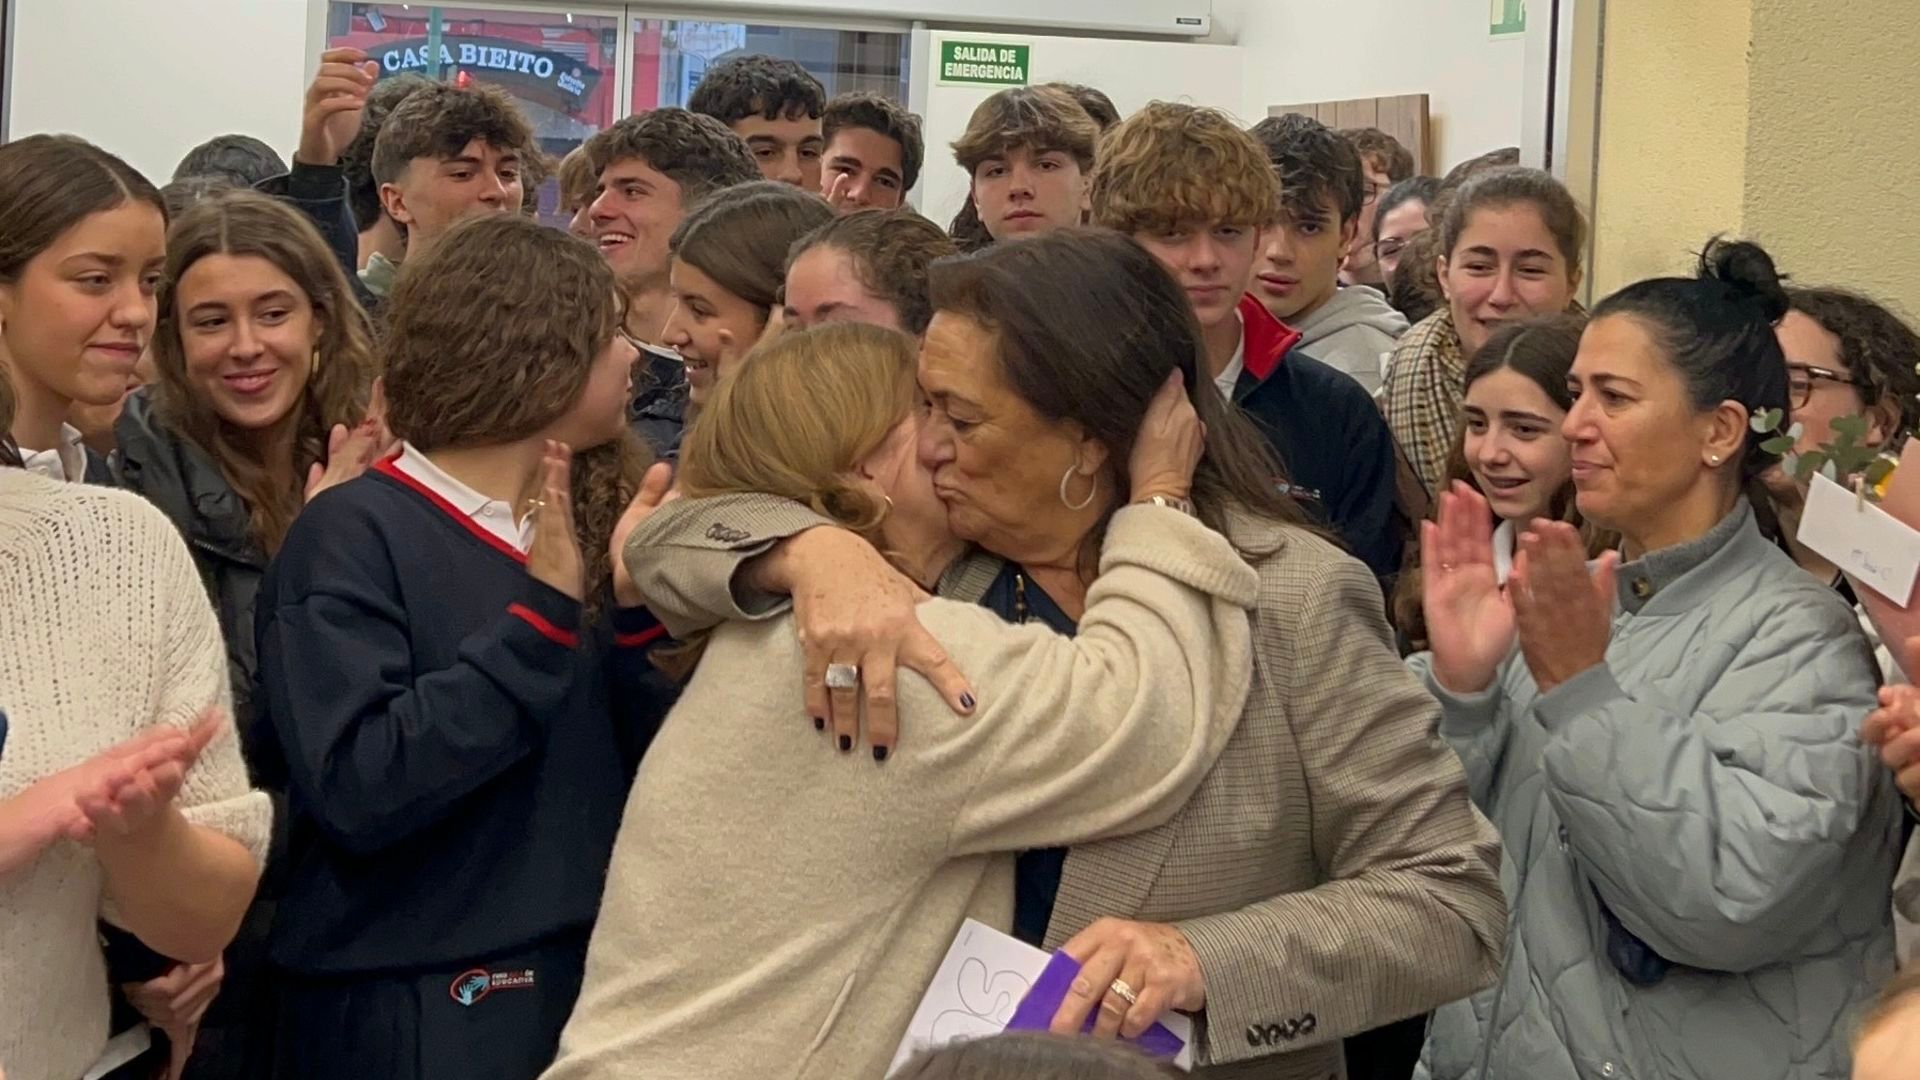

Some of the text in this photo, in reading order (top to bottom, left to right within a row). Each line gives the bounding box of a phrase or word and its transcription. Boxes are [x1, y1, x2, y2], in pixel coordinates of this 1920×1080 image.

[383, 43, 554, 78] CASA BIEITO
[953, 46, 1017, 63] SALIDA DE
[944, 62, 1024, 80] EMERGENCIA
